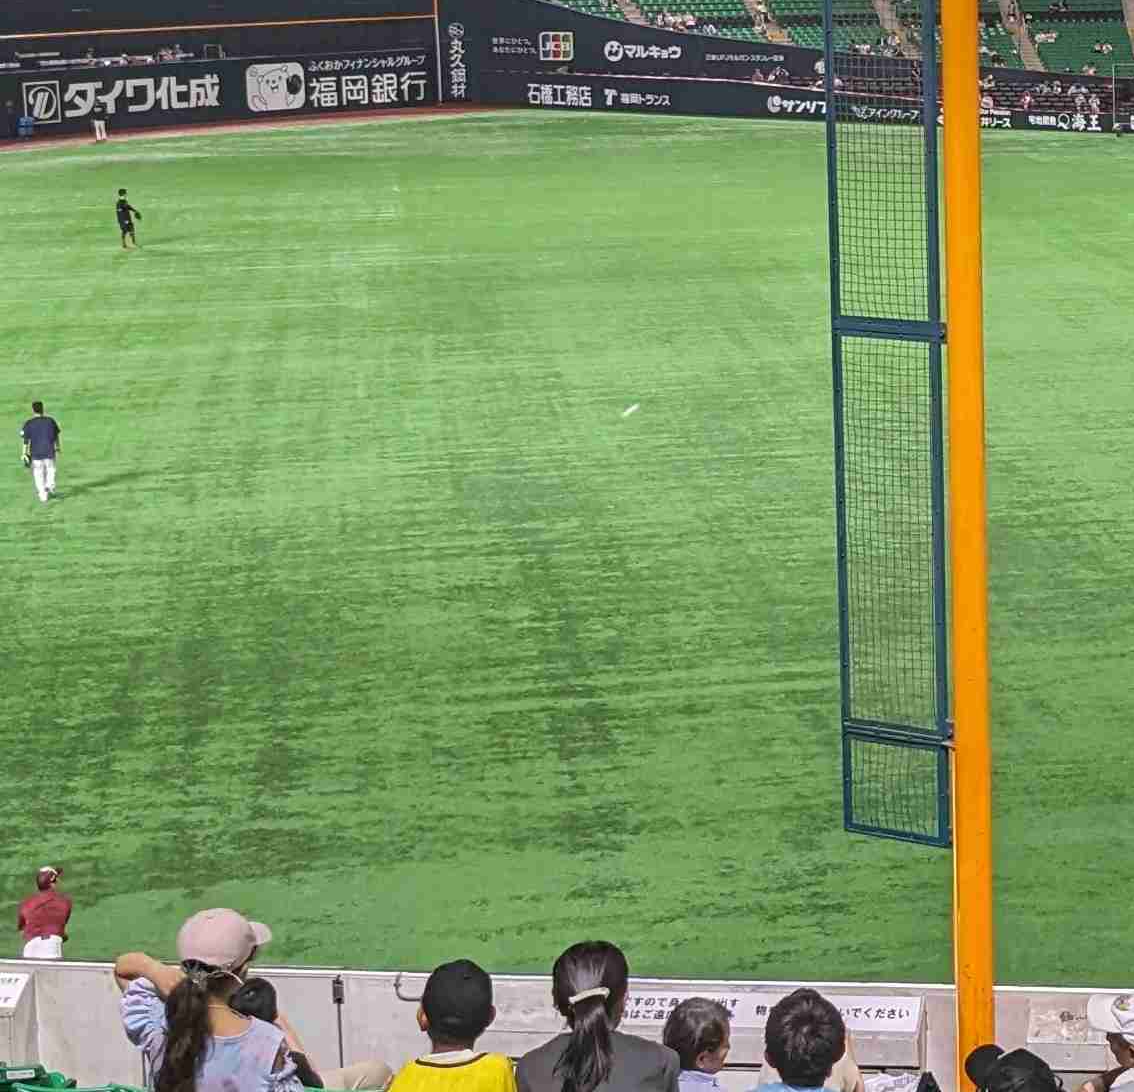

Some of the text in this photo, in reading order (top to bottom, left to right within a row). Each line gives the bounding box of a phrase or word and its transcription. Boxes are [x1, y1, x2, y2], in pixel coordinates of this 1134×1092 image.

[308, 55, 426, 72] ふくおかフィナンシャルグループ
[623, 44, 682, 59] マルキョウ
[64, 74, 220, 118] ダイワ化成
[309, 71, 427, 107] 福岡銀行
